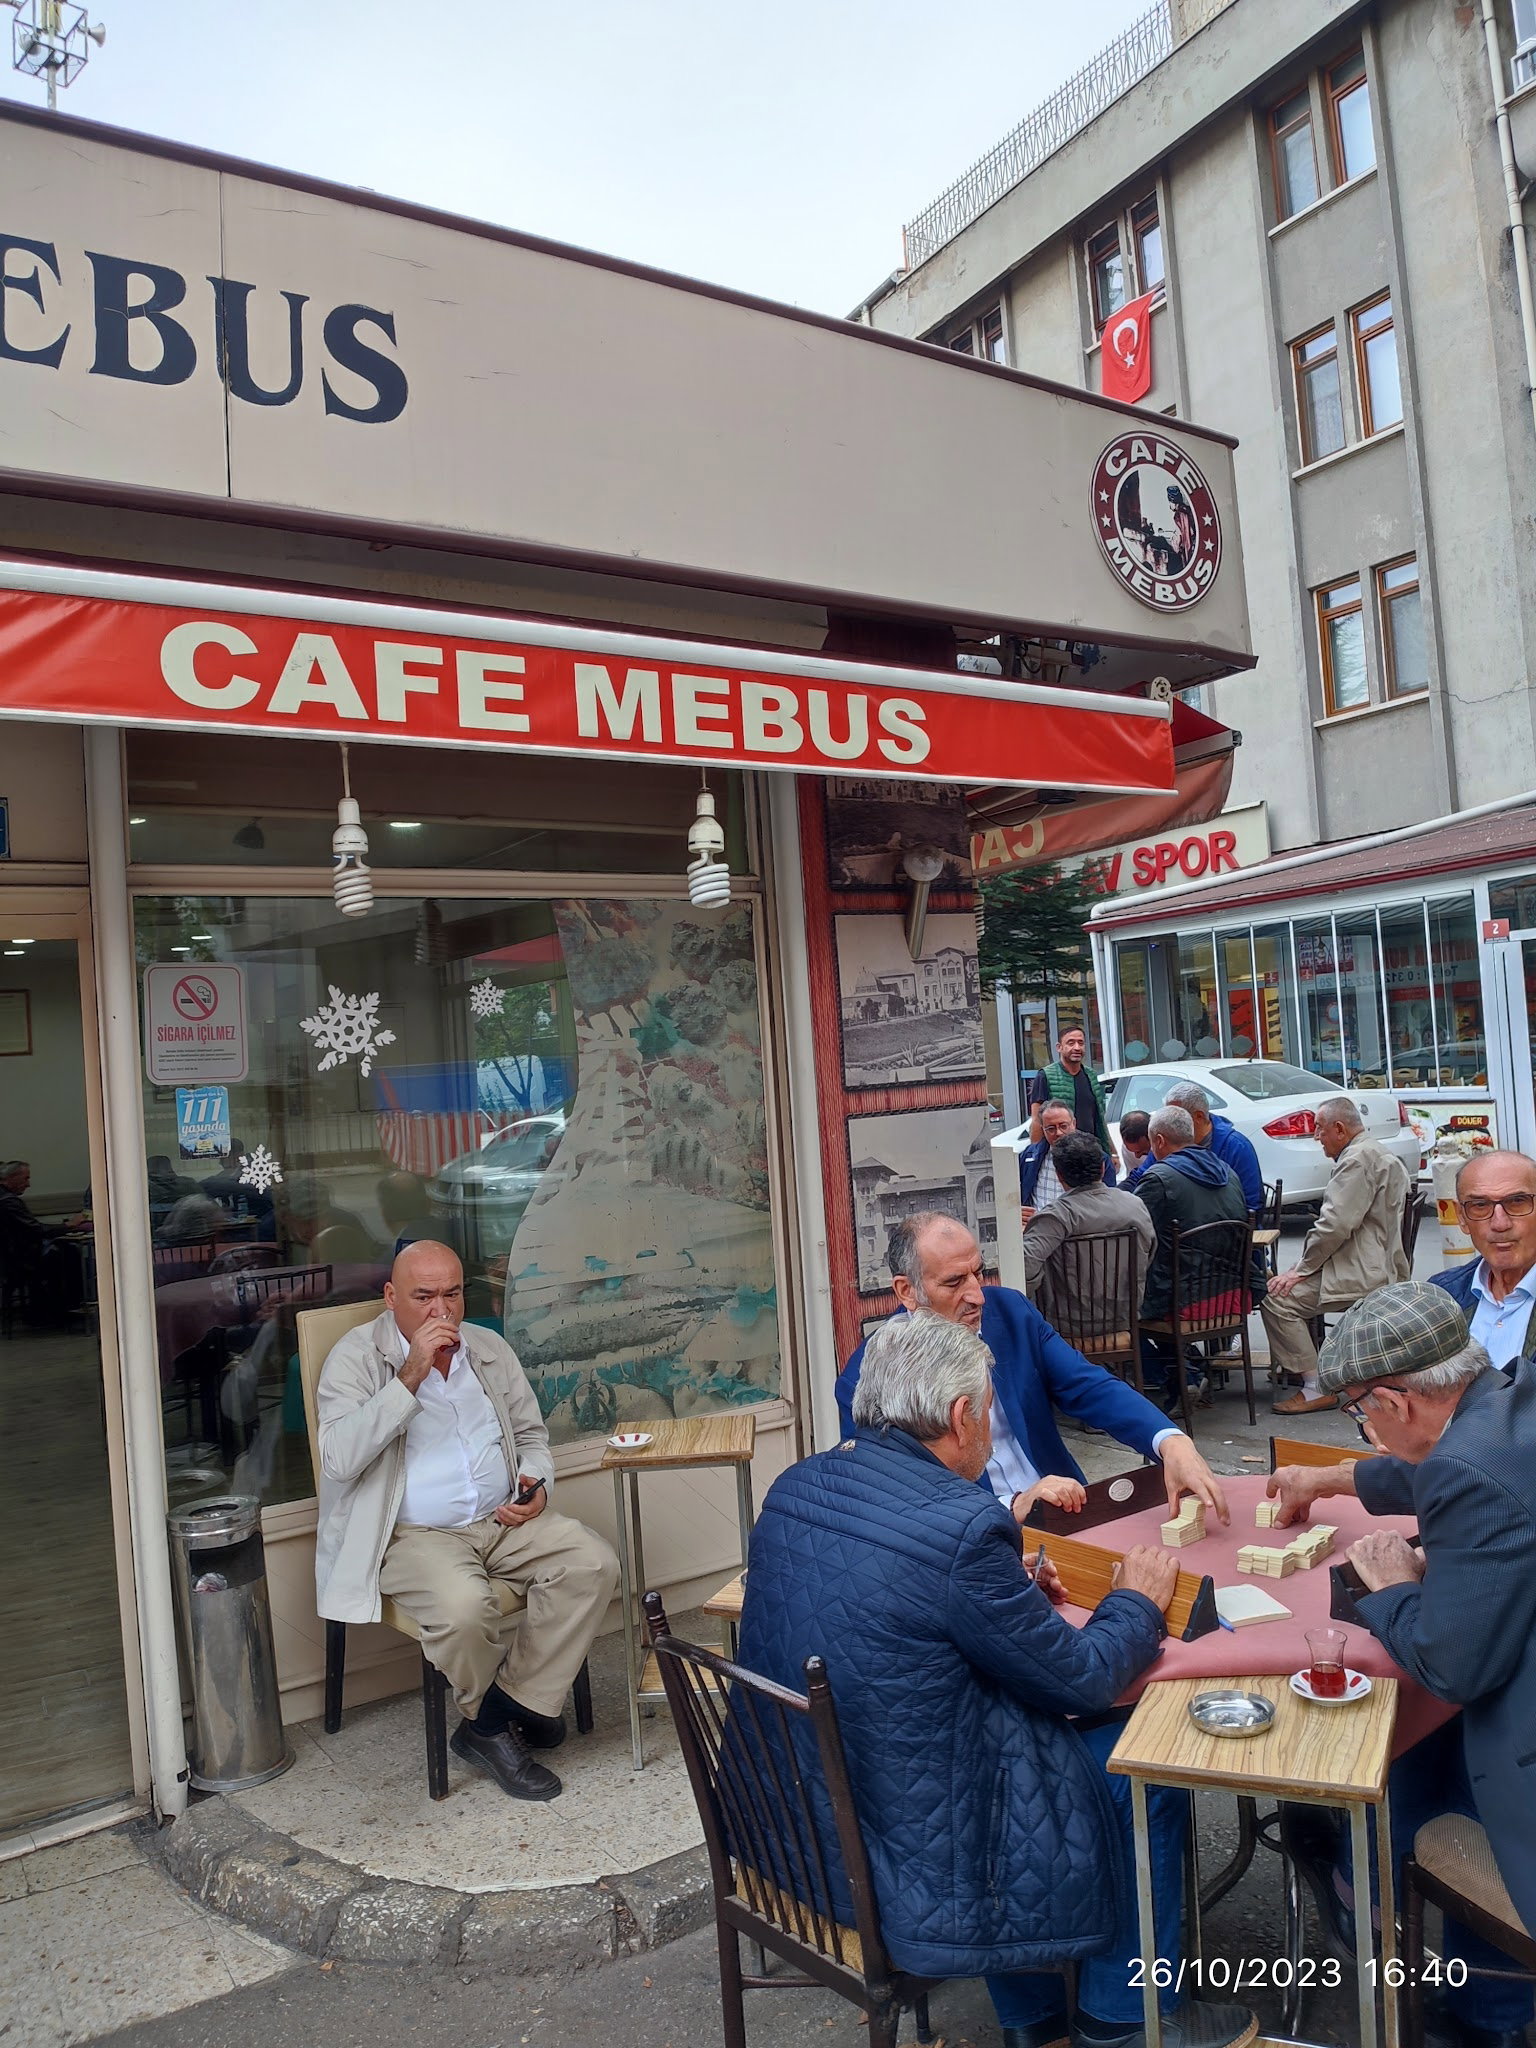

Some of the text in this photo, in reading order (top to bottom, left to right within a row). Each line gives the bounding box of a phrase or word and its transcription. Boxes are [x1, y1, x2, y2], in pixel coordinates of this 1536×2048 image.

[0, 233, 409, 424] EBUS
[1105, 439, 1203, 495] CAFE
[1105, 537, 1213, 603] MEBUS
[160, 620, 931, 765] CAFE MEBUS
[1132, 830, 1240, 887] SPOR
[1492, 923, 1499, 935] 2
[157, 1023, 236, 1045] SİGARA İÇİLMEZ
[183, 1096, 222, 1124] 111
